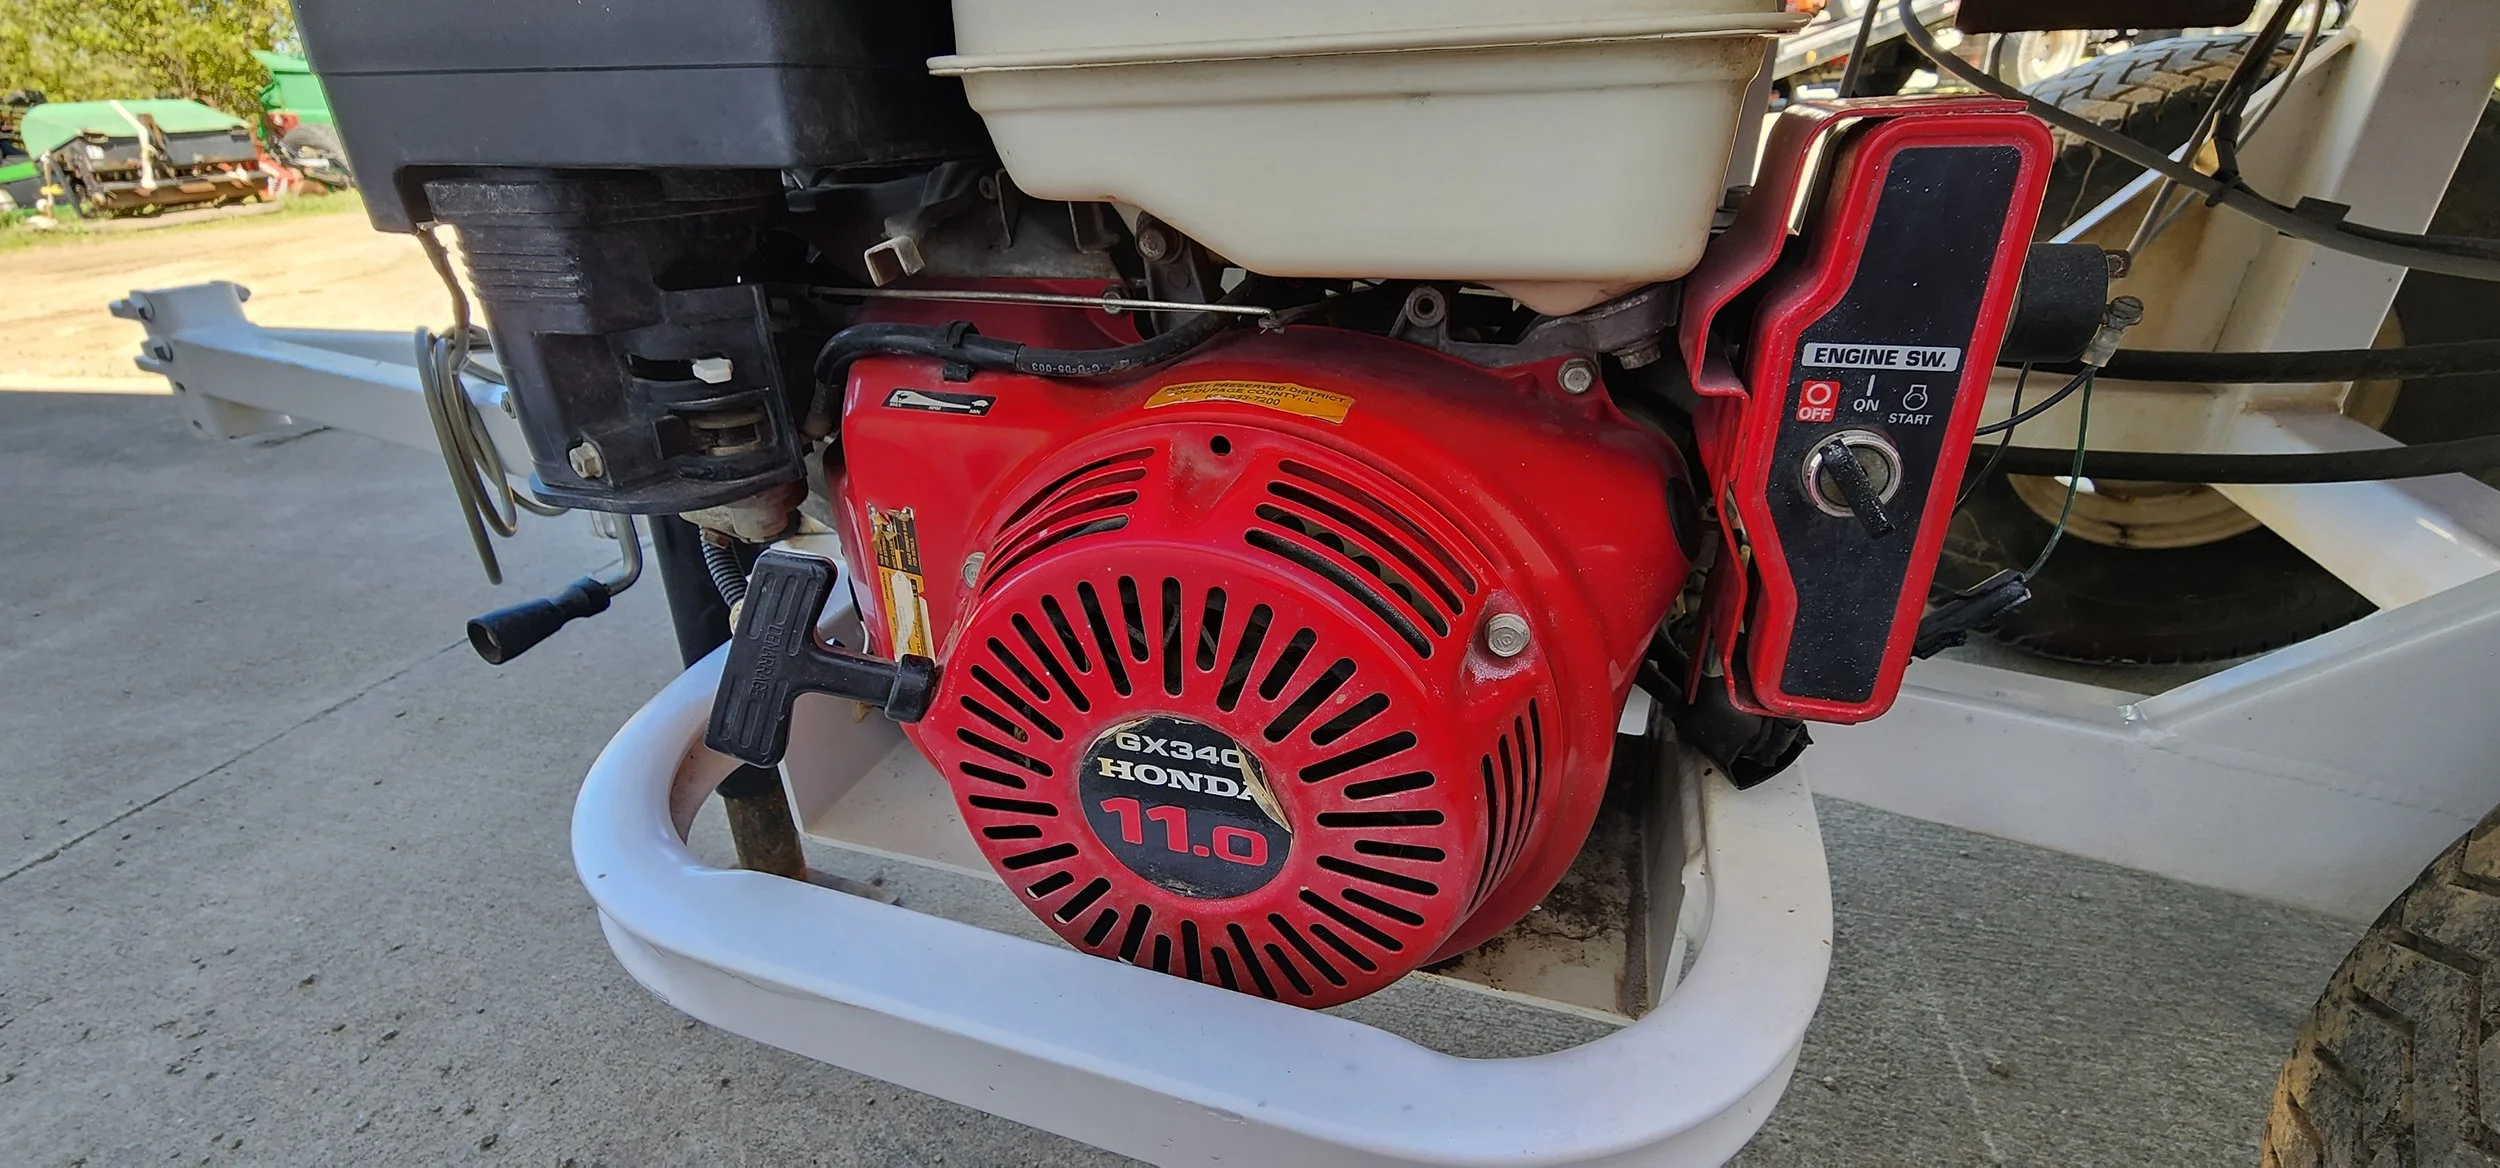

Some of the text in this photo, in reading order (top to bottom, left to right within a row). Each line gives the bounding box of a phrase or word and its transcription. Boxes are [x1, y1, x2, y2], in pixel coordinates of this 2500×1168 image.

[1814, 347, 1947, 367] ENGINE SW.
[1214, 382, 1286, 391] PRESERVED
[1289, 387, 1346, 403] DISTRICT
[1799, 407, 1832, 420] OFF
[1853, 399, 1880, 412] ON
[1888, 413, 1933, 425] START
[1115, 732, 1243, 768] GX340
[1100, 797, 1269, 867] 11.0
